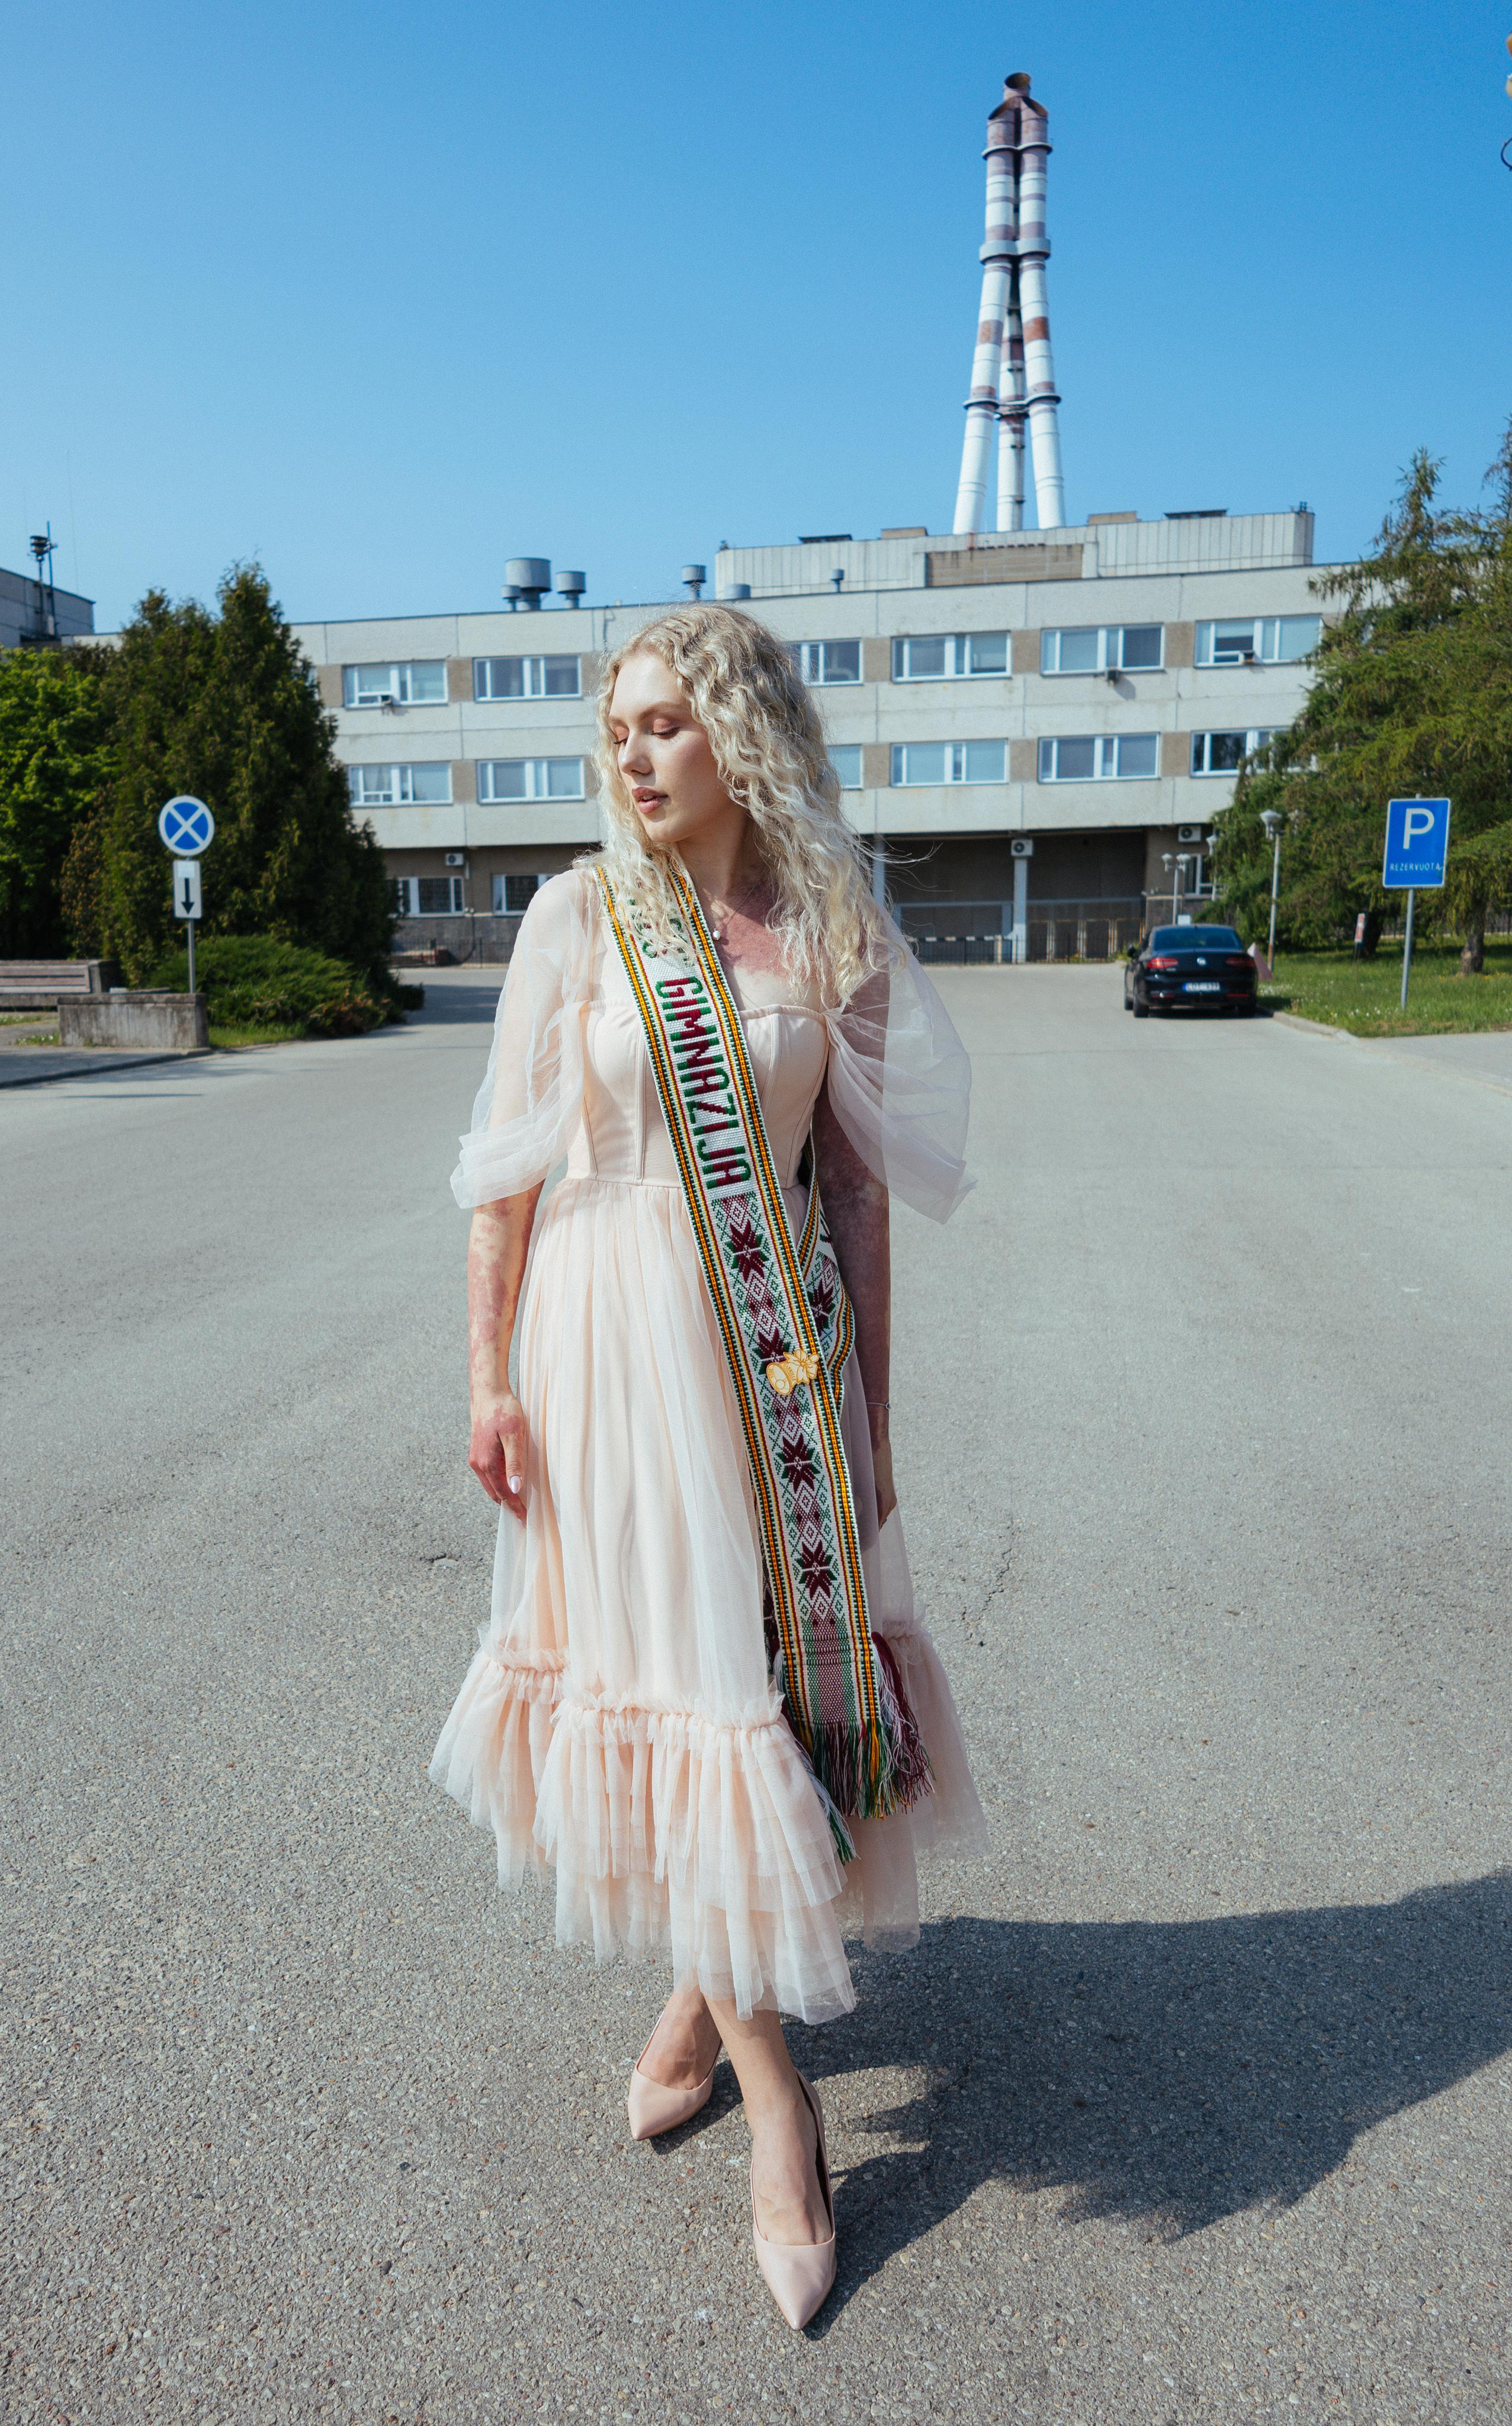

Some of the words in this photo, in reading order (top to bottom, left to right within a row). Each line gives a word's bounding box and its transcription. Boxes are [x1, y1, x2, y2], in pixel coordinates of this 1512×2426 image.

[1403, 808, 1435, 849] P
[1390, 862, 1442, 871] REZERVUOTA
[655, 976, 751, 1189] GIMNAZIJA
